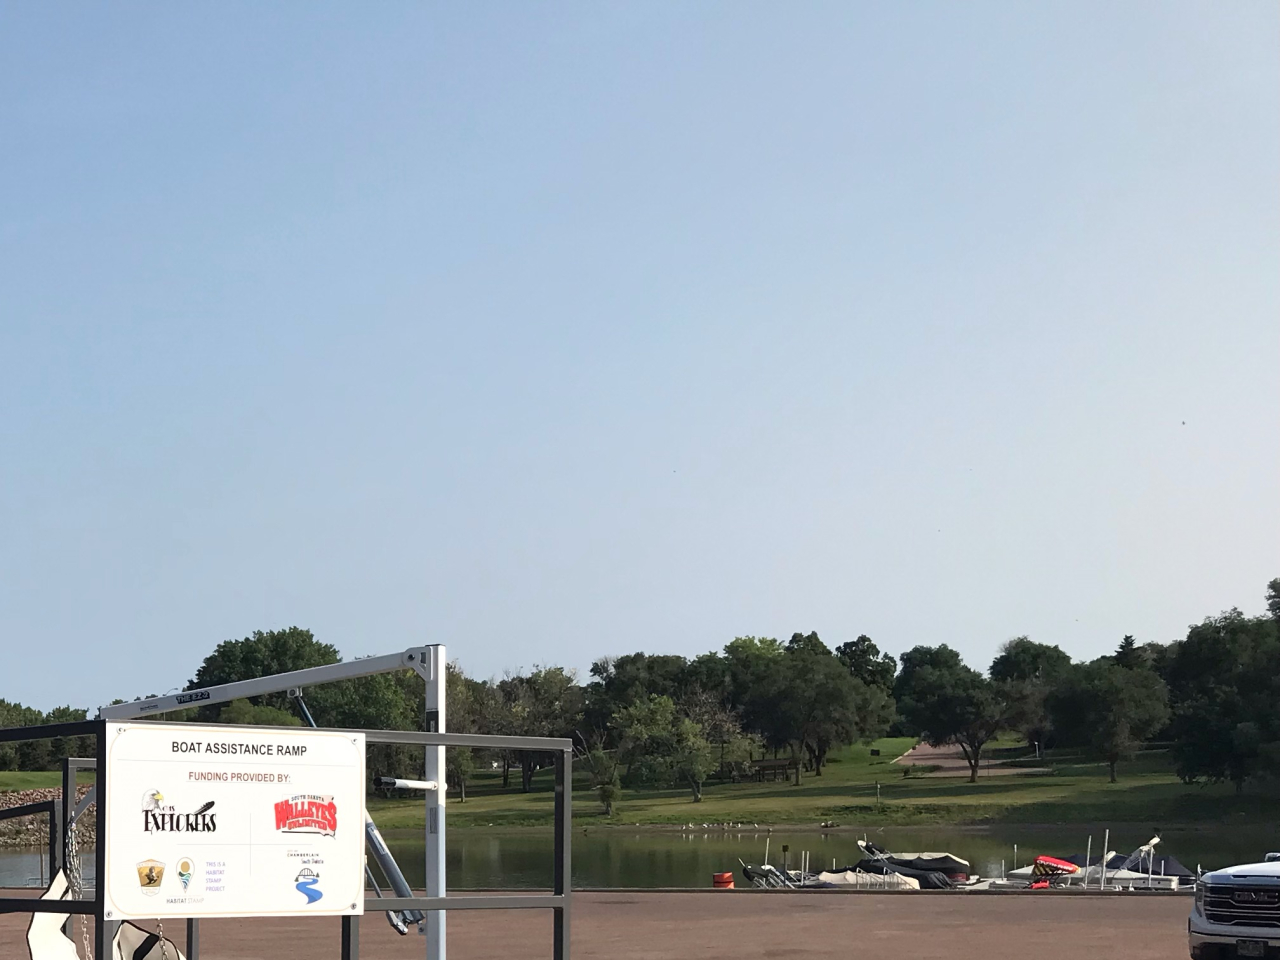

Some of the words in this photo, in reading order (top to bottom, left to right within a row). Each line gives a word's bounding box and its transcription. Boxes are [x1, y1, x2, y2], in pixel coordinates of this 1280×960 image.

[177, 695, 191, 703] THE
[172, 741, 202, 753] BOAT
[205, 743, 273, 755] ASSISTANCE
[276, 745, 307, 757] RAMP
[188, 771, 228, 781] FUNDING
[231, 772, 275, 782] PROVIDED
[277, 774, 291, 783] BY:
[142, 809, 217, 834] EXPLORERS
[274, 799, 337, 831] WALLEYES
[287, 819, 327, 830] UNLIMITED
